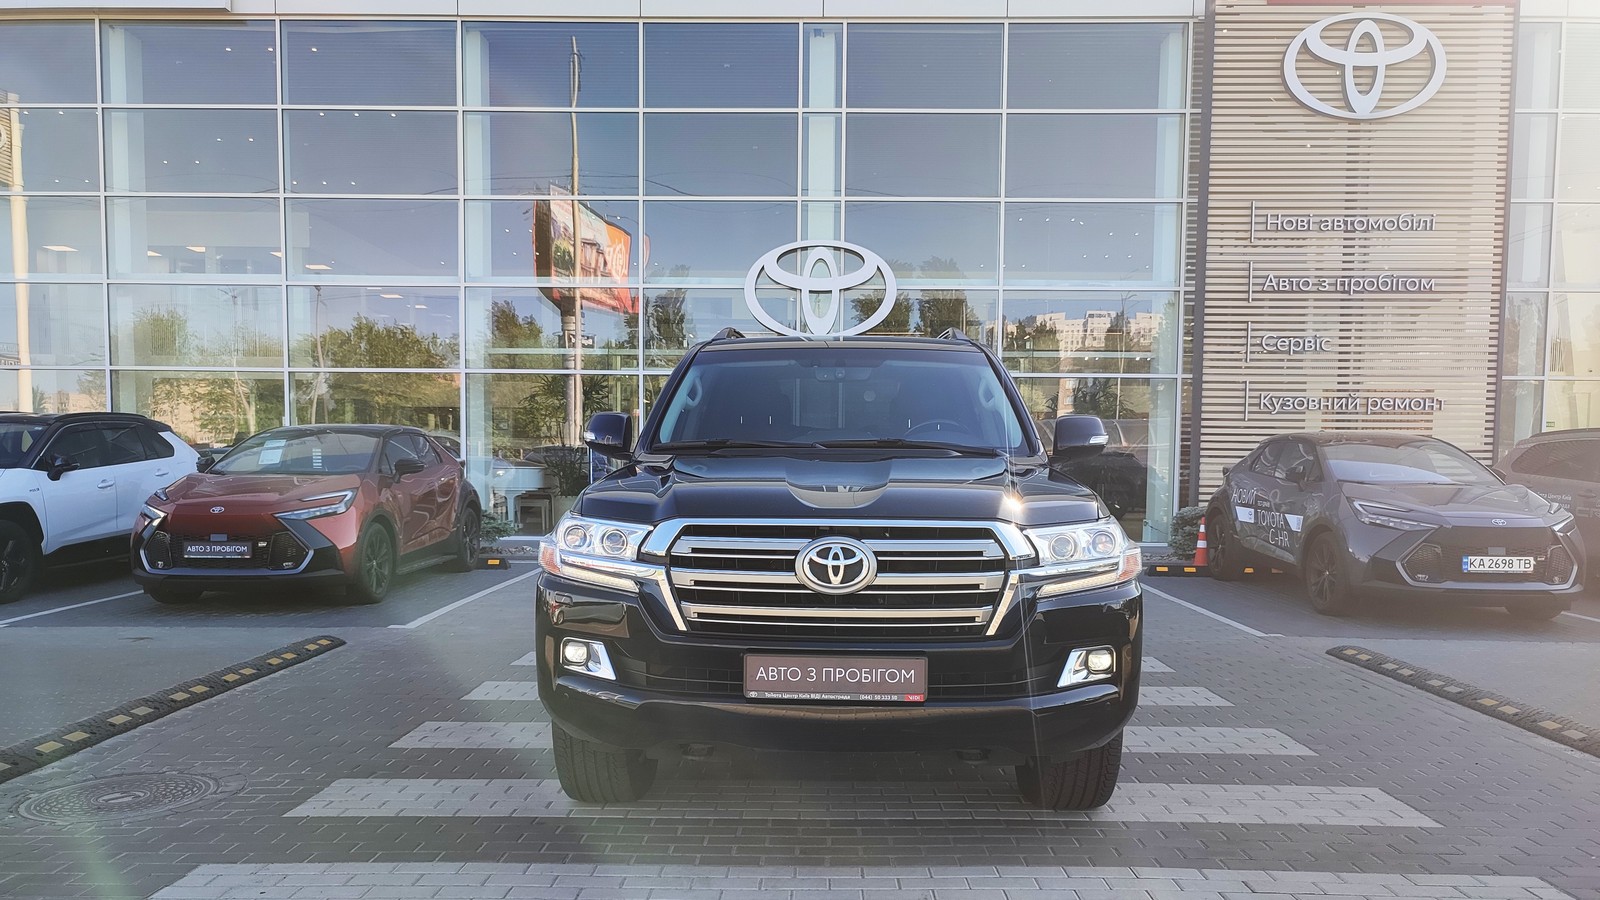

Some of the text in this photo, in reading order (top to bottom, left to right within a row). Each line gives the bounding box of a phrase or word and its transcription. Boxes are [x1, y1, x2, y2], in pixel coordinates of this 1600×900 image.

[1266, 213, 1437, 231] Нові автомобілі
[1262, 273, 1435, 296] Авто з пробігом
[1261, 333, 1333, 356] Сервіс
[1258, 392, 1446, 415] Кузовний ремонт
[1257, 509, 1285, 529] TOYOTA
[1269, 528, 1290, 548] C-HR
[211, 545, 248, 553] ПРОБІГОМ
[1469, 558, 1485, 569] KA
[1487, 558, 1514, 569] 2698
[1516, 558, 1532, 569] TB
[756, 667, 916, 684] АВТО З ПРОБІГОМ
